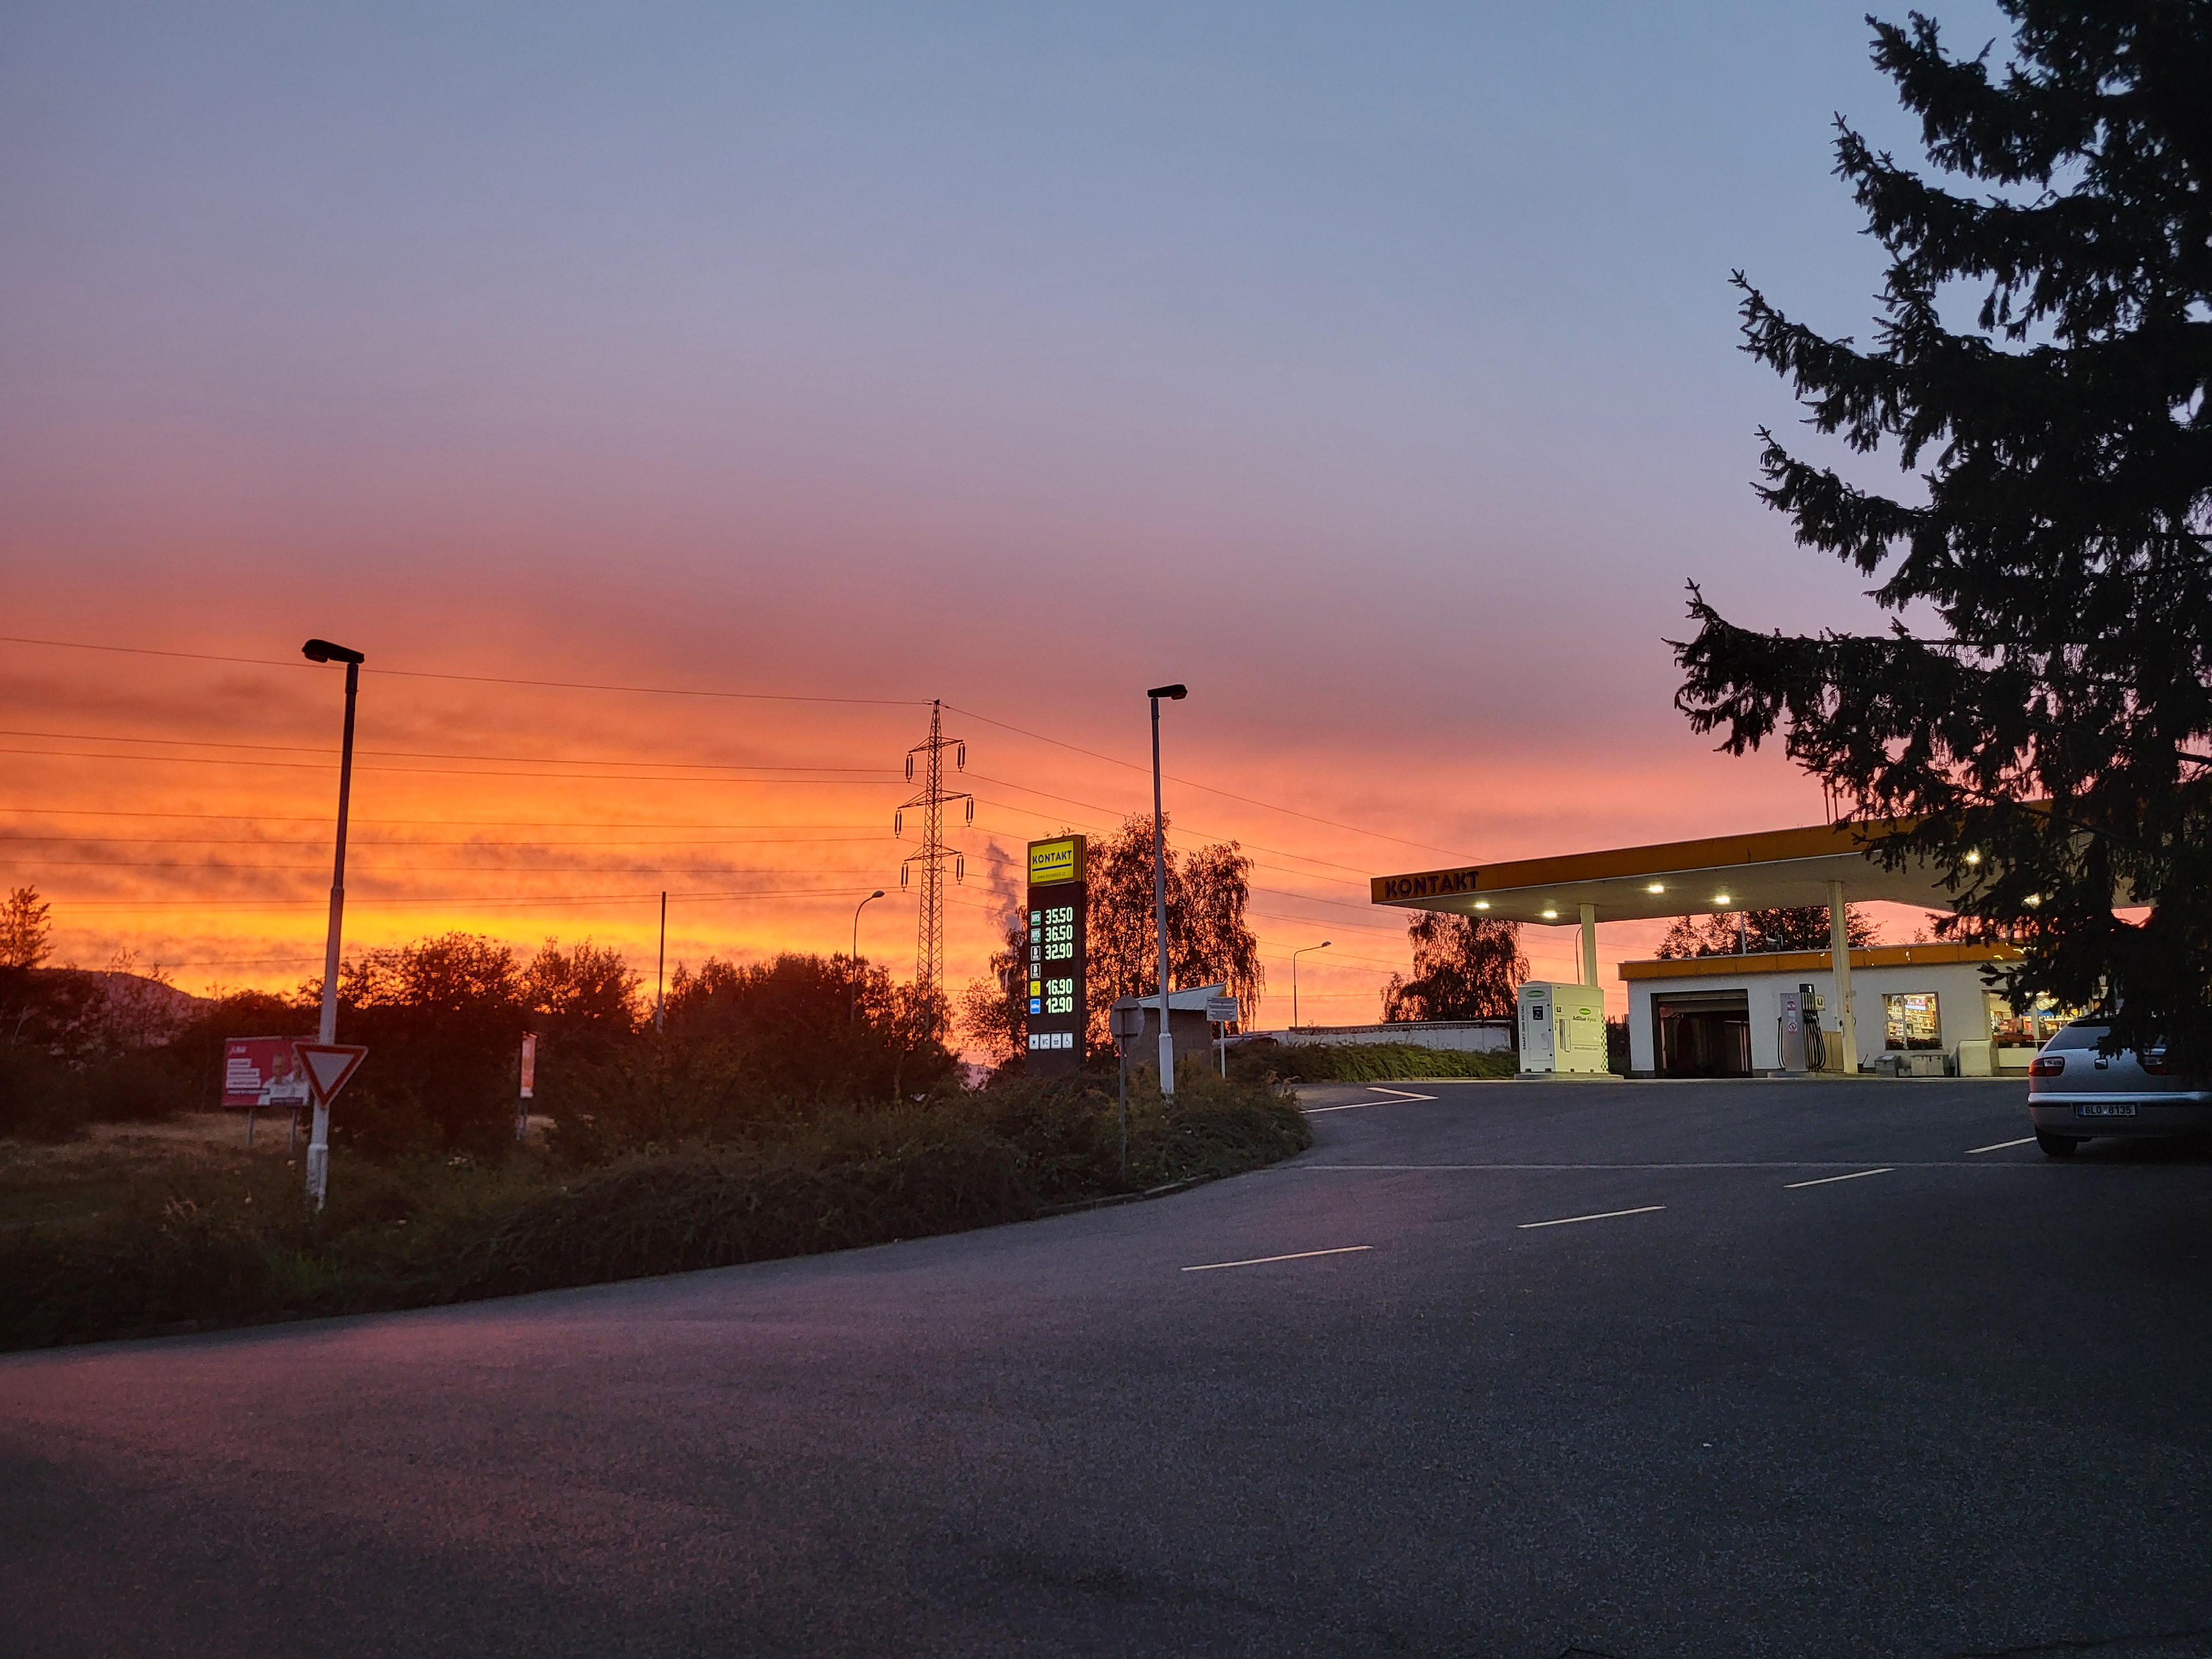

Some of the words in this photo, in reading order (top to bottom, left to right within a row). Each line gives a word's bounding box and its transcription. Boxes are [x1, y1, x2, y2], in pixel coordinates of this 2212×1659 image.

[1032, 850, 1072, 865] KONTAKT
[1385, 871, 1479, 899] KONTAKT
[1045, 907, 1073, 925] 35.50
[1045, 925, 1073, 942] 36.50
[1045, 942, 1073, 960] 32.90
[1046, 978, 1073, 995] 16.90
[1045, 997, 1073, 1014] 12.90
